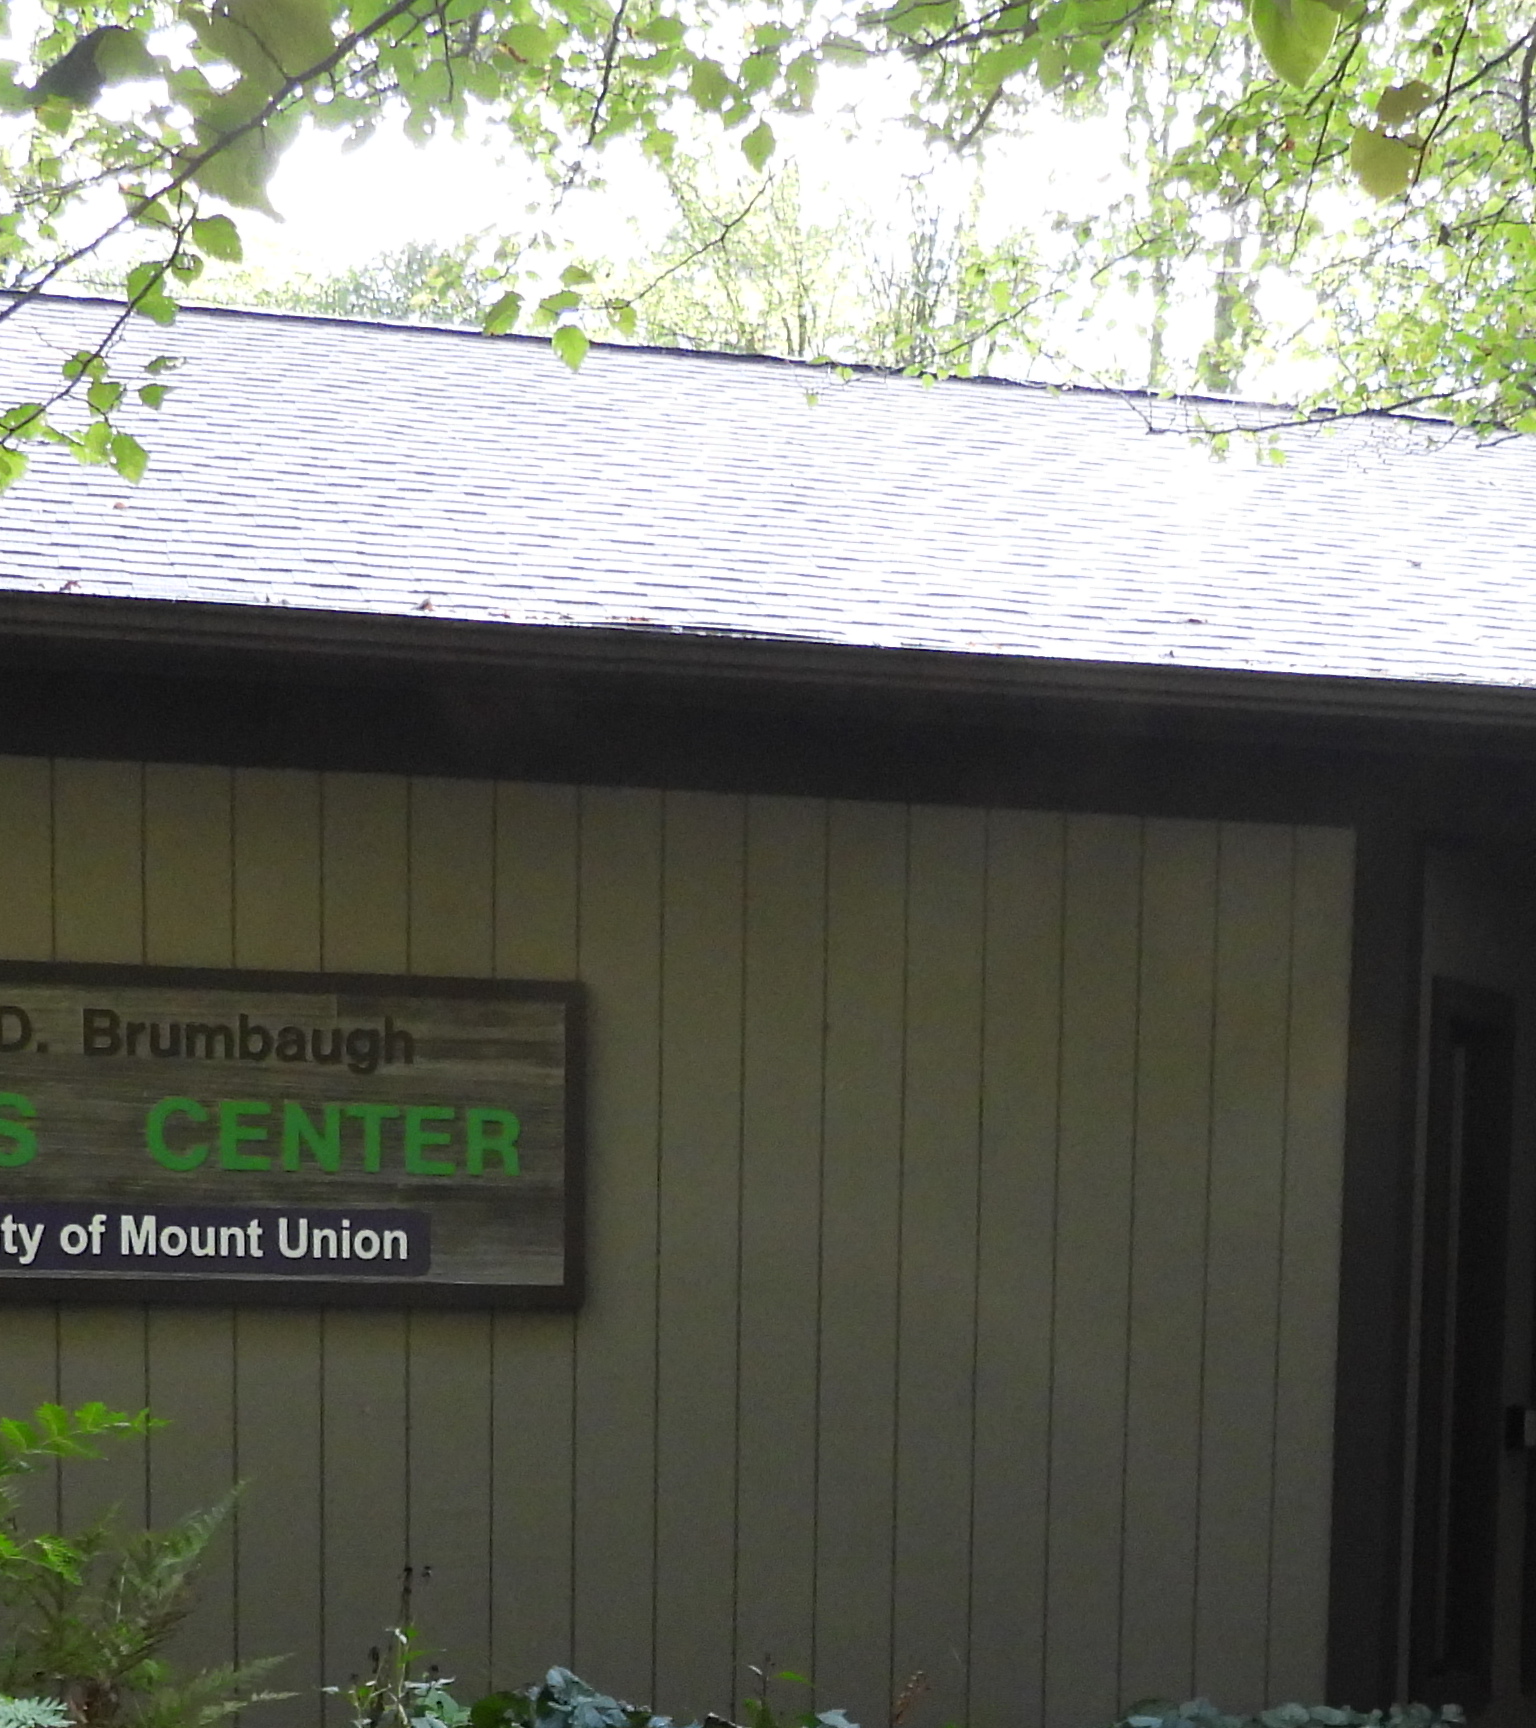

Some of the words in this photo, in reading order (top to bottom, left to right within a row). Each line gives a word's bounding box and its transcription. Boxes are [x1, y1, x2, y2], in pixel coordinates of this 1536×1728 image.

[81, 1007, 416, 1075] Brumbaugh
[145, 1097, 522, 1178] CENTER
[59, 1214, 106, 1256] of
[119, 1214, 264, 1259] Mount
[277, 1217, 409, 1261] Union
